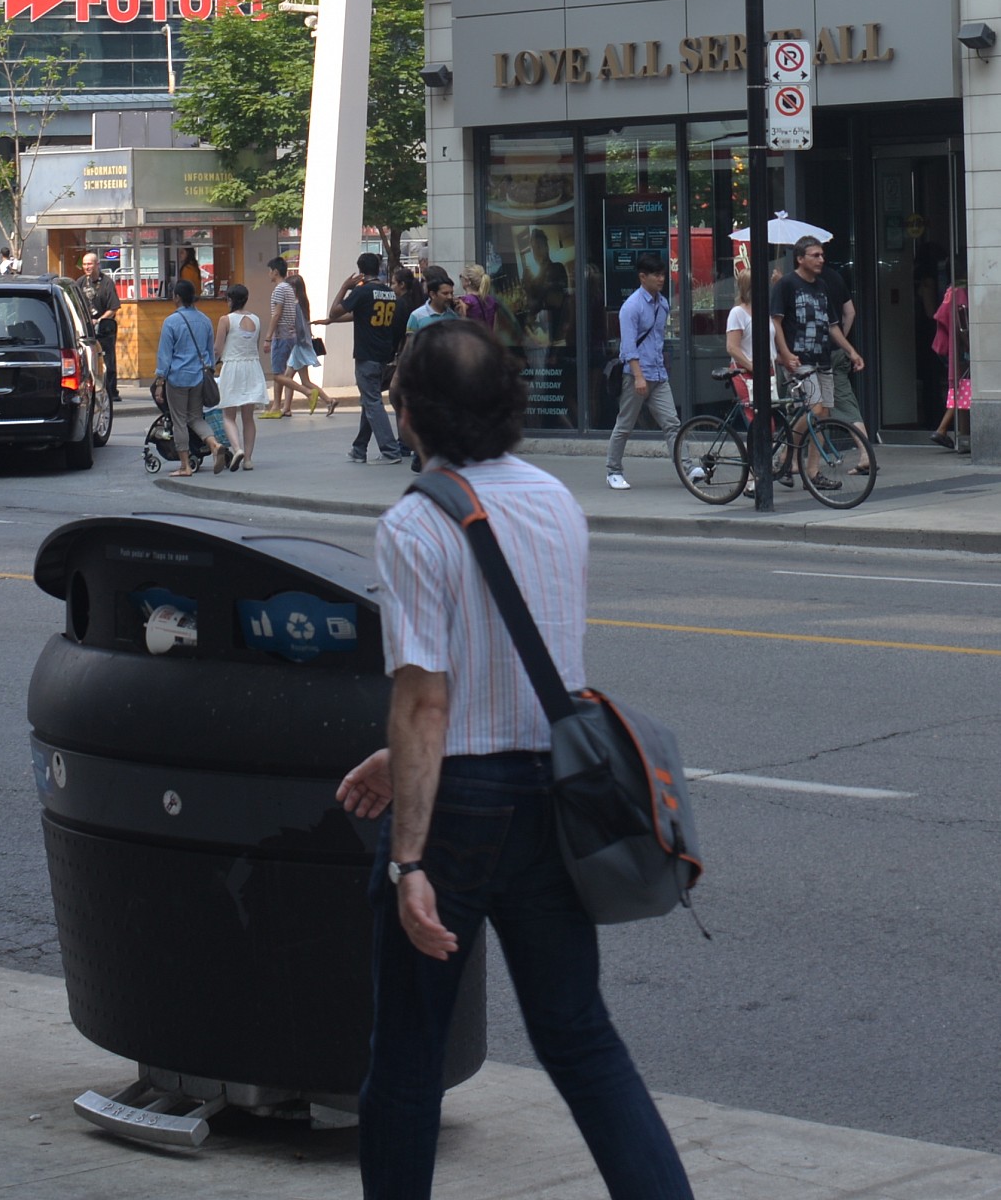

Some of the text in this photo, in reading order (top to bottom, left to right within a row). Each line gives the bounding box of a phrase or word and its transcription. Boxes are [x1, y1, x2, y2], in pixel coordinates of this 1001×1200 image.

[493, 22, 894, 89] LOVE ALL SER ALL
[184, 172, 234, 182] INFORMATIO
[628, 201, 663, 213] afterdark
[370, 301, 396, 327] 36
[534, 368, 563, 376] MONDAY
[536, 407, 568, 415] THURSDAY
[101, 1102, 161, 1125] PRESS
